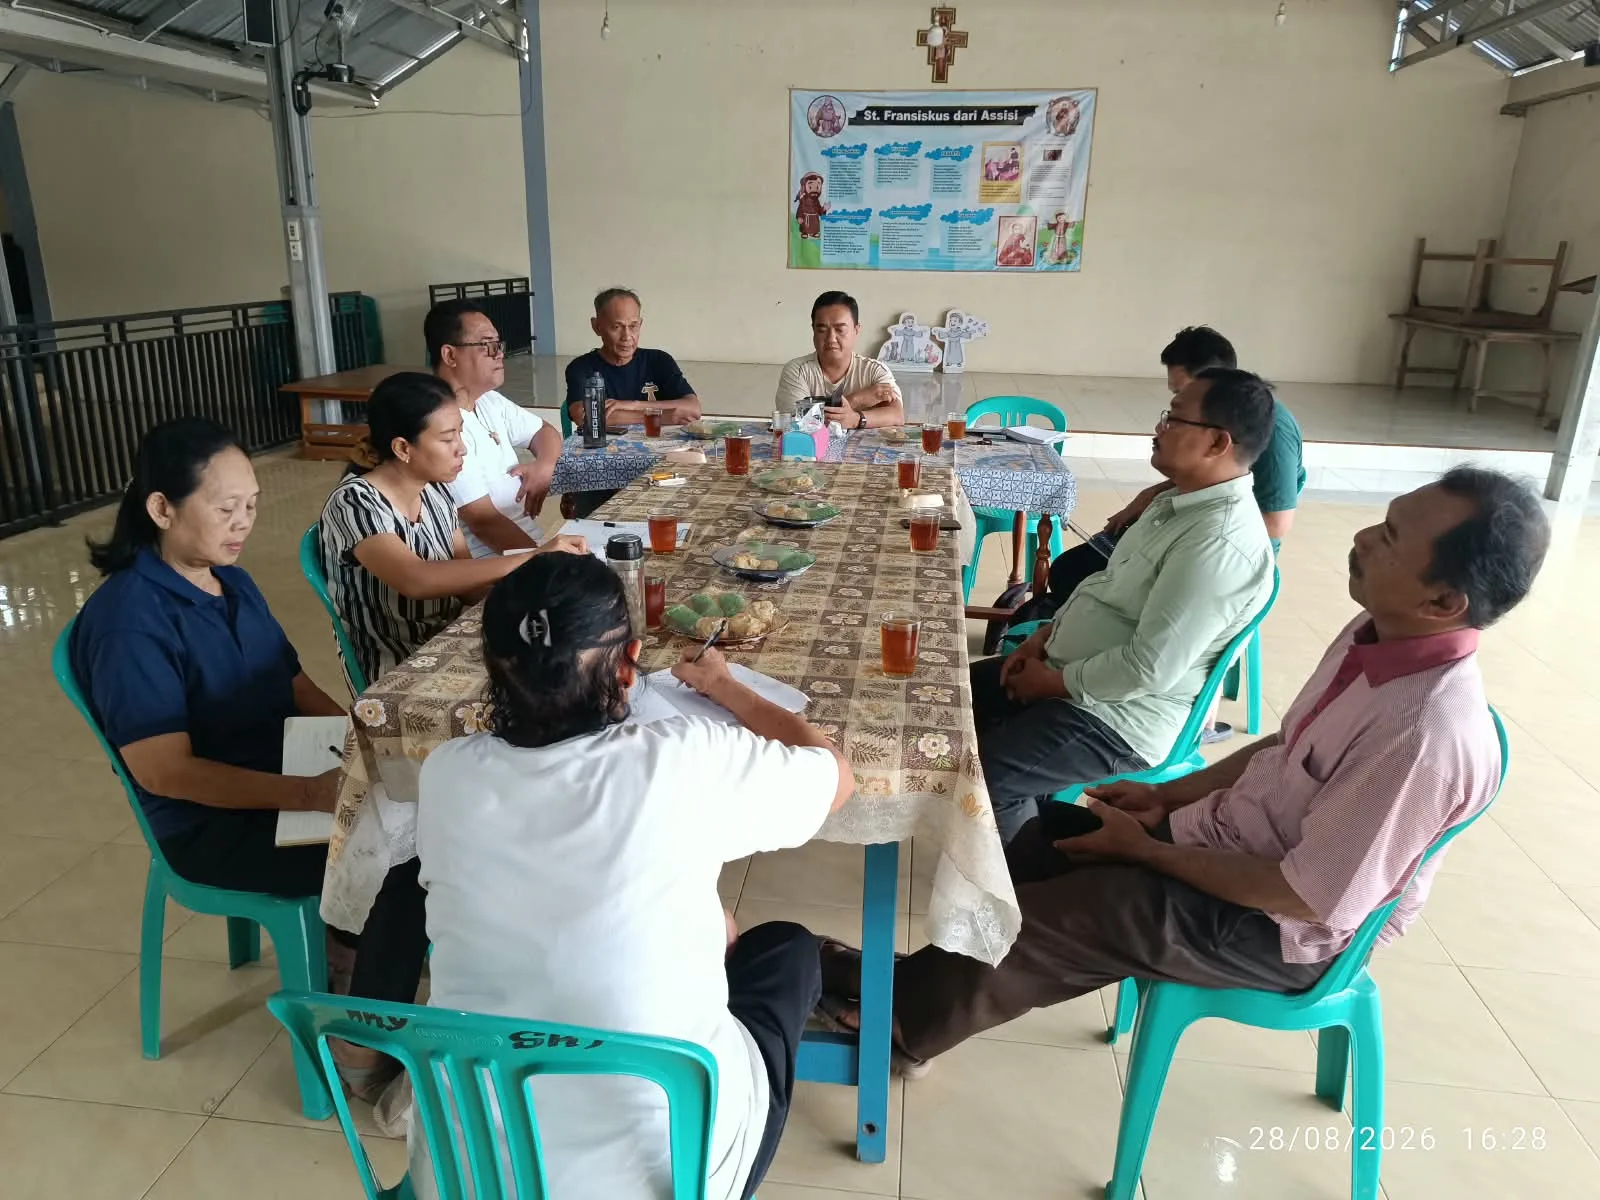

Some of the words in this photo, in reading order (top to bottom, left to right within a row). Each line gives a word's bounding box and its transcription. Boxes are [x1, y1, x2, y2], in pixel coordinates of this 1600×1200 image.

[864, 110, 880, 121] St.
[884, 110, 950, 121] Fransiskus
[953, 109, 978, 121] dari
[981, 109, 1018, 121] Assisi
